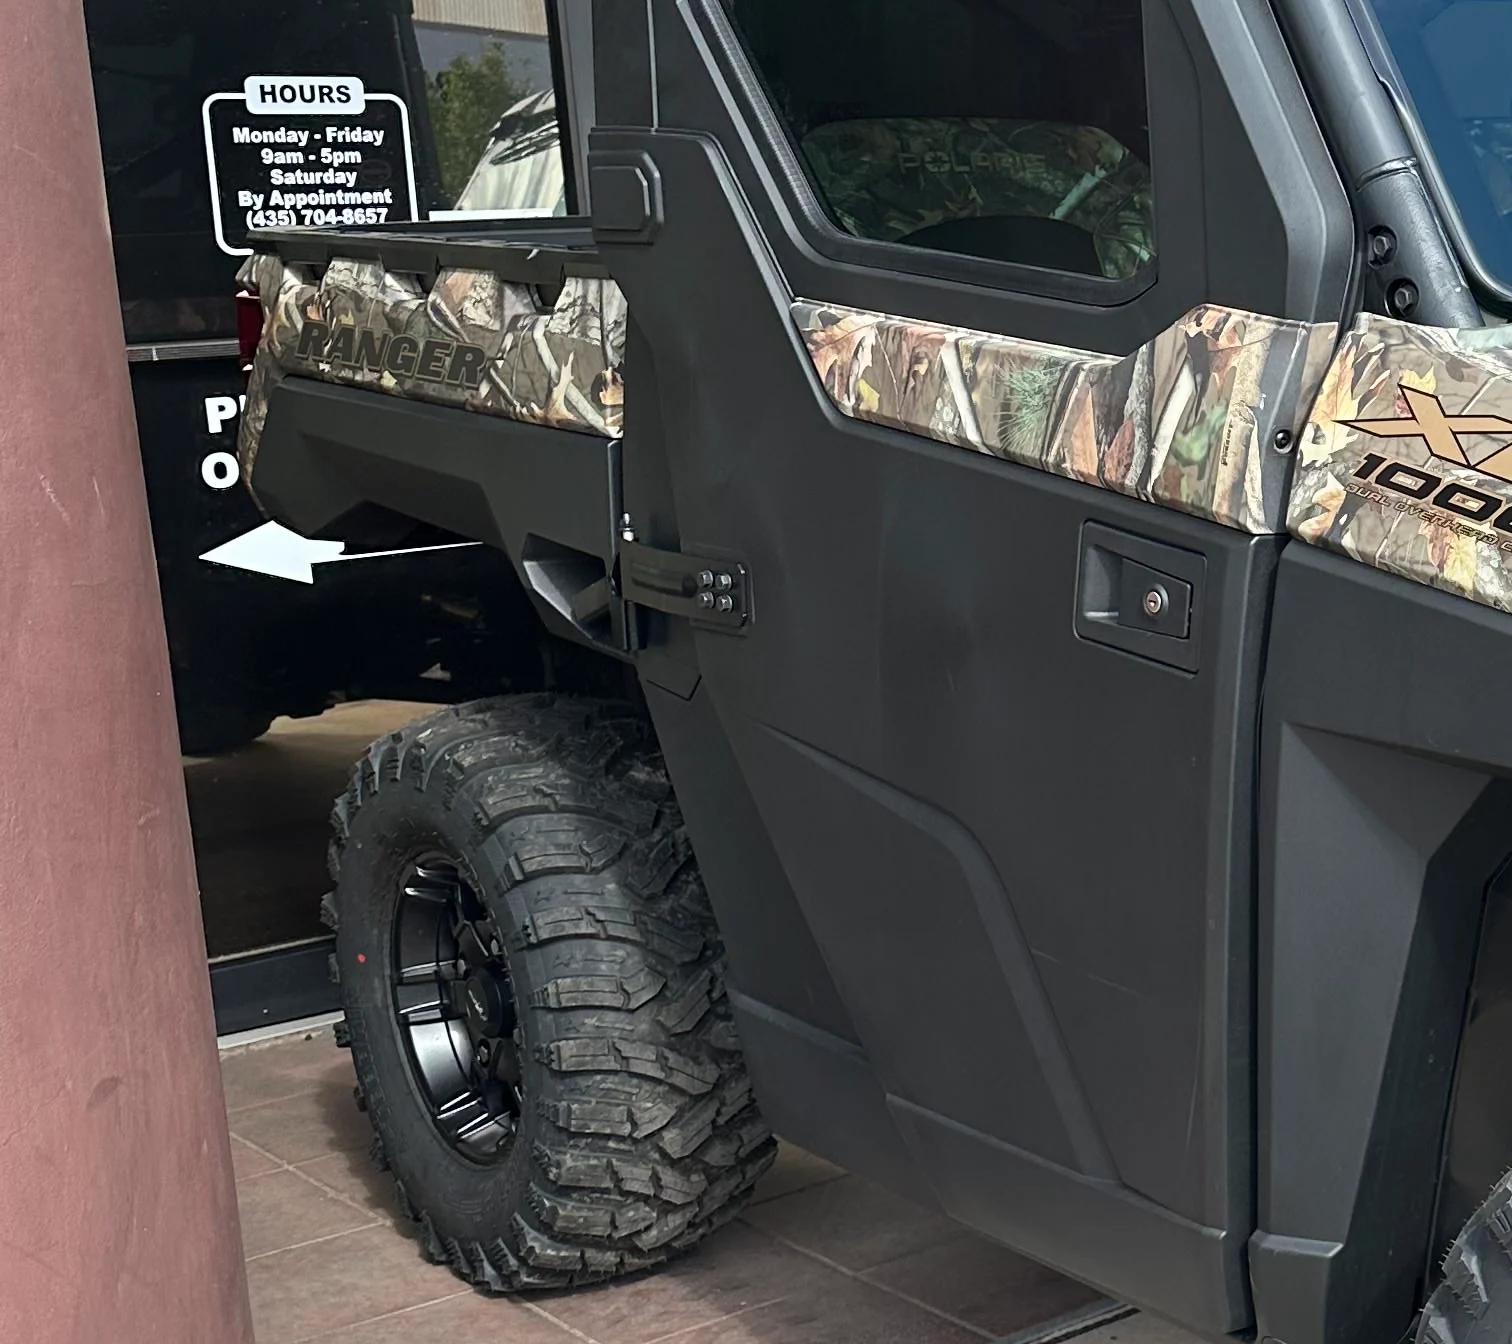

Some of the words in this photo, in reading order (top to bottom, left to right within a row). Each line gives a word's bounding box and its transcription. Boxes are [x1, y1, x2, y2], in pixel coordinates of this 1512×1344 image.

[259, 84, 352, 104] HOURS
[232, 126, 309, 146] Monday
[325, 126, 385, 146] Friday
[261, 149, 304, 165] 9am
[320, 149, 362, 167] 5pm
[270, 169, 357, 187] Saturday
[238, 190, 263, 210] By
[269, 188, 393, 209] Appointment
[246, 209, 297, 227] (435)
[301, 208, 389, 225] 704-8657
[297, 321, 486, 388] RANGER
[1344, 481, 1391, 508] DUAL
[1394, 498, 1500, 545] OVERHEAD
